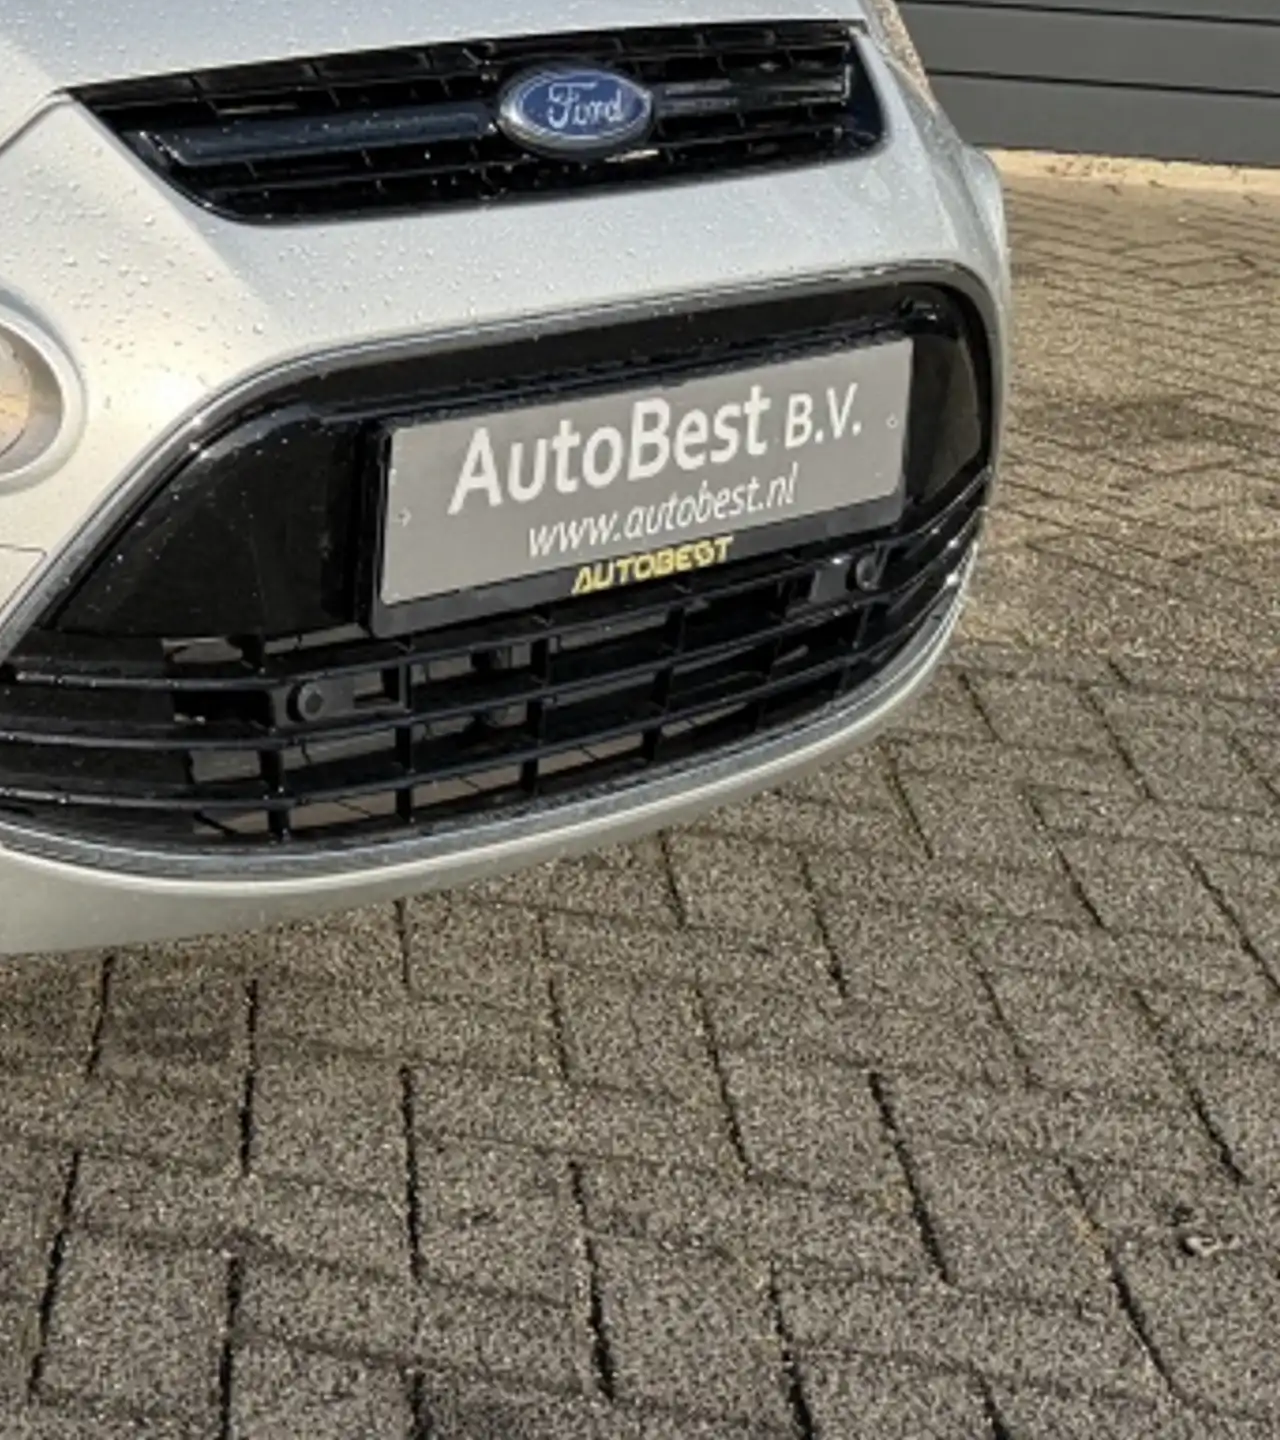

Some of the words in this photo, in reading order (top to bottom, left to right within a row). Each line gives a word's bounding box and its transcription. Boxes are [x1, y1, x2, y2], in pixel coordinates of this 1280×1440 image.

[547, 81, 623, 129] Ford
[447, 385, 771, 515] AutoBest
[784, 383, 862, 450] B.V.
[528, 462, 798, 558] www.autobest.nl
[571, 536, 734, 595] AUTOBEST
